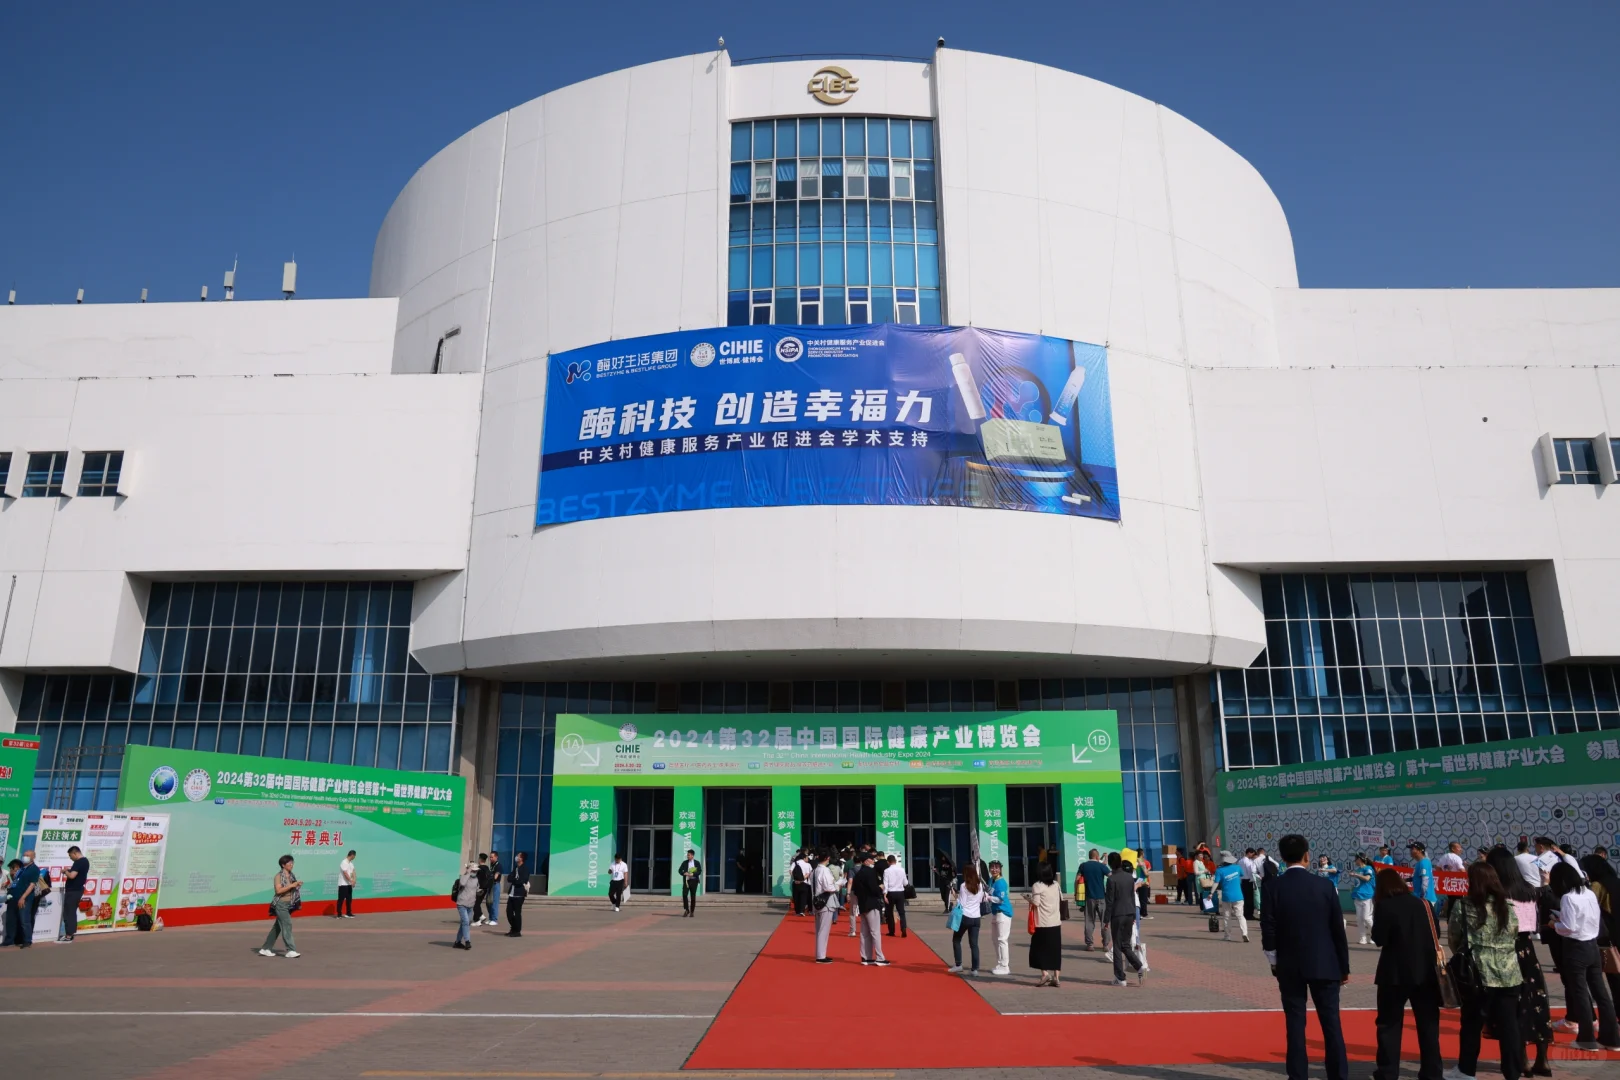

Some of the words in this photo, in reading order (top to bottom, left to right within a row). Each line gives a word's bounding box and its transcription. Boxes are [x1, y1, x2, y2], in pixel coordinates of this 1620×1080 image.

[719, 339, 764, 356] CIHIE
[596, 349, 678, 372] 酶好生活集团
[578, 396, 697, 441] 酶科技
[714, 389, 933, 426] 创造幸福力
[578, 429, 929, 465] 中关村健康服务产业促进会学术支持
[653, 724, 1041, 750] 2024第32届中国国际健康产业博览会
[1092, 735, 1107, 746] 1B
[566, 739, 580, 749] 1A
[615, 744, 640, 753] CIHIE
[897, 751, 914, 759] Expo
[1236, 761, 1396, 790] 2024第32届中国国际健康产业博览会
[1406, 744, 1566, 776] 第十一届世界健康产业大会
[216, 771, 453, 801] 2024第32届中国国际健康产业博览会暨第十一届世界健康产业大会
[579, 799, 600, 810] 欢迎
[1074, 796, 1094, 806] 欢迎
[579, 811, 600, 822] 参观
[679, 811, 696, 819] 欢迎
[778, 811, 795, 819] 欢迎
[881, 810, 899, 818] 欢迎
[984, 809, 1001, 818] 欢迎
[1075, 809, 1095, 819] 参观
[679, 820, 696, 830] 参观
[778, 820, 795, 830] 参观
[882, 819, 899, 829] 参观
[984, 819, 1002, 828] 参观
[43, 831, 79, 841] 关注领水
[290, 830, 344, 846] 开幕典礼
[587, 825, 599, 889] WELCOME
